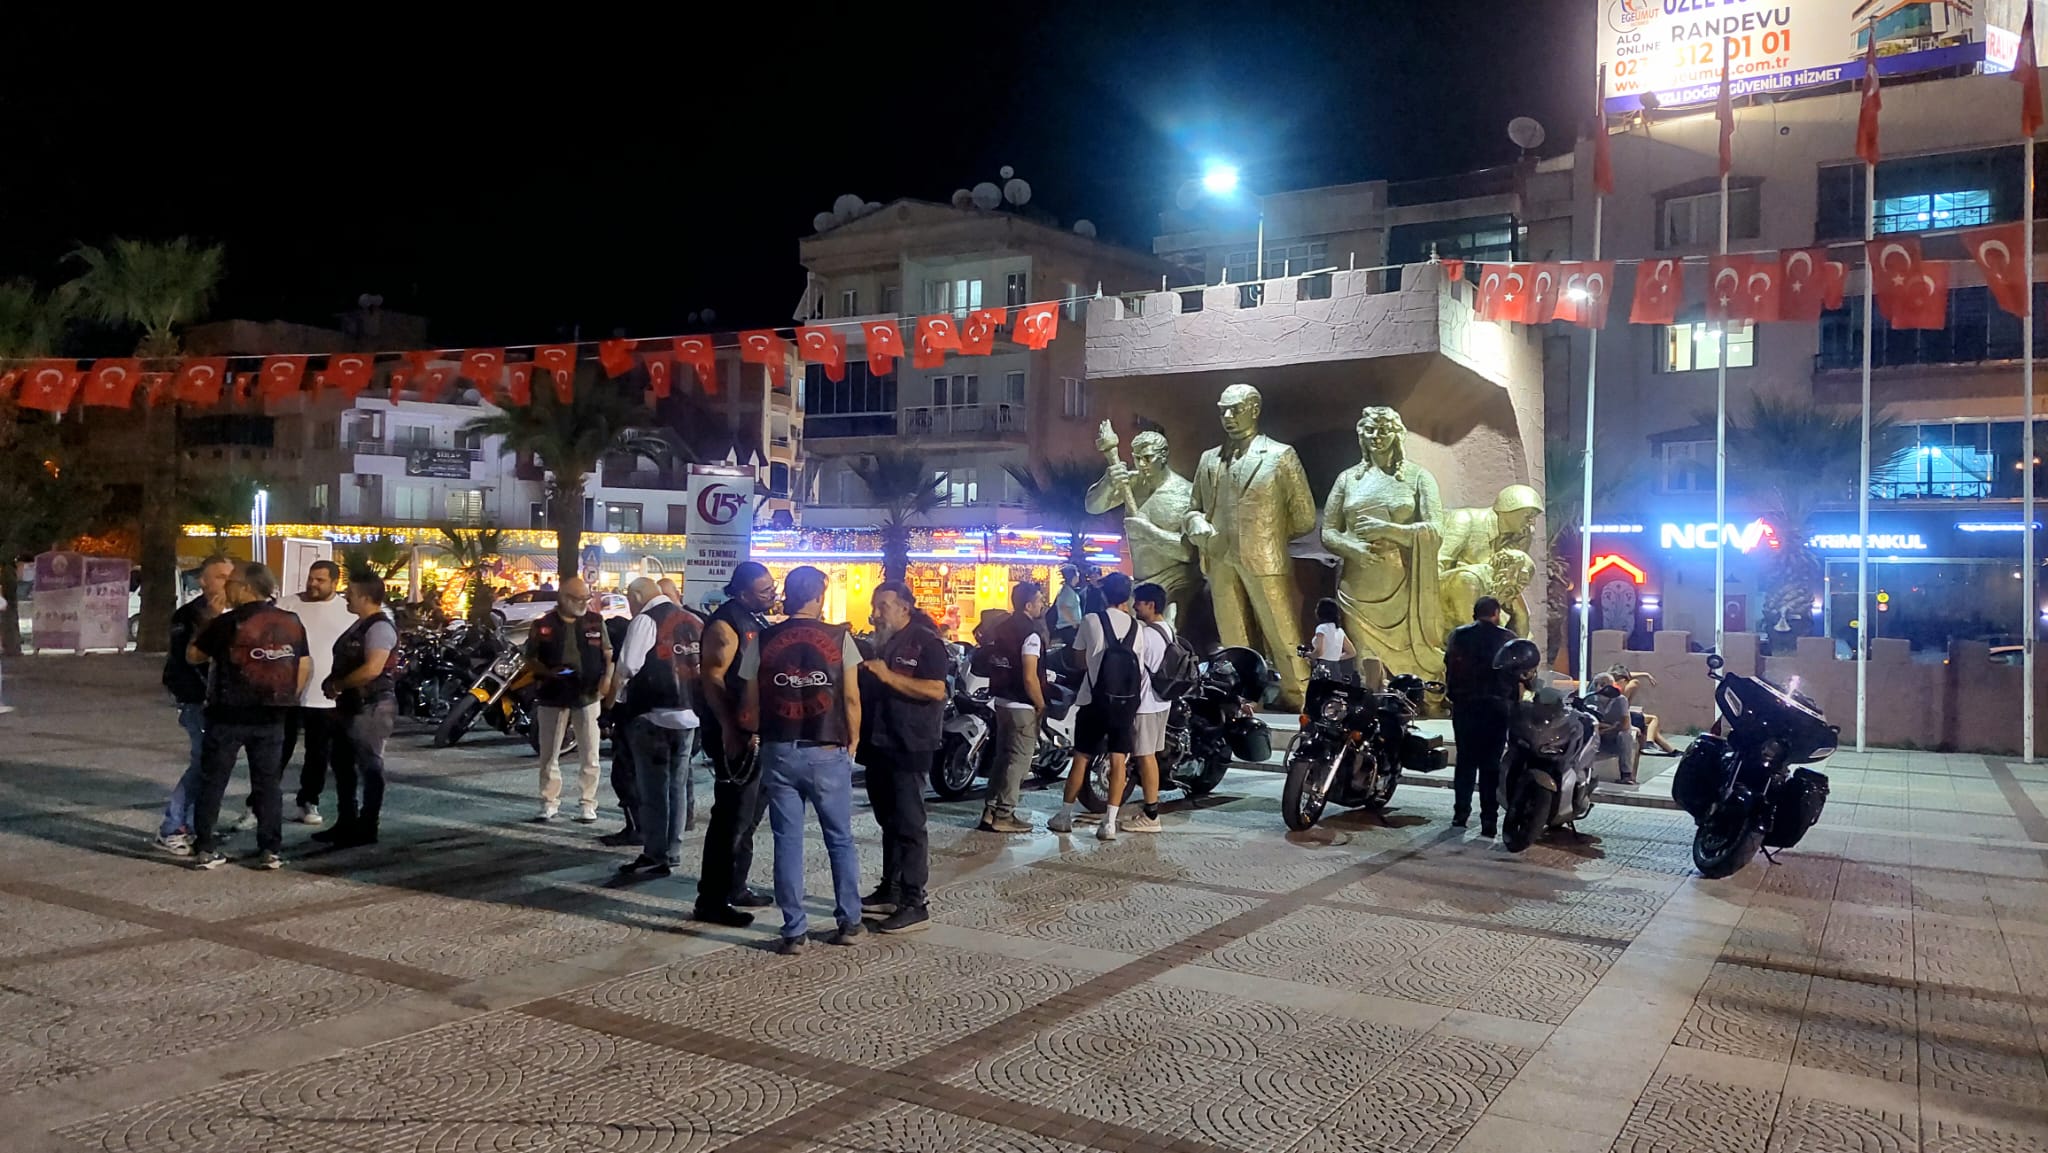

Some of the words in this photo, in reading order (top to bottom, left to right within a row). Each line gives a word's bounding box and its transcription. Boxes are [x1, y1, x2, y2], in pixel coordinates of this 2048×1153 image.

[1671, 6, 1791, 43] RANDEVU
[1616, 32, 1641, 46] ALO
[1616, 41, 1662, 57] ONLINE
[1761, 29, 1791, 55] 01
[1729, 70, 1792, 95] GÜVENİLİR
[1795, 67, 1842, 85] HİZMET
[711, 493, 738, 520] 15
